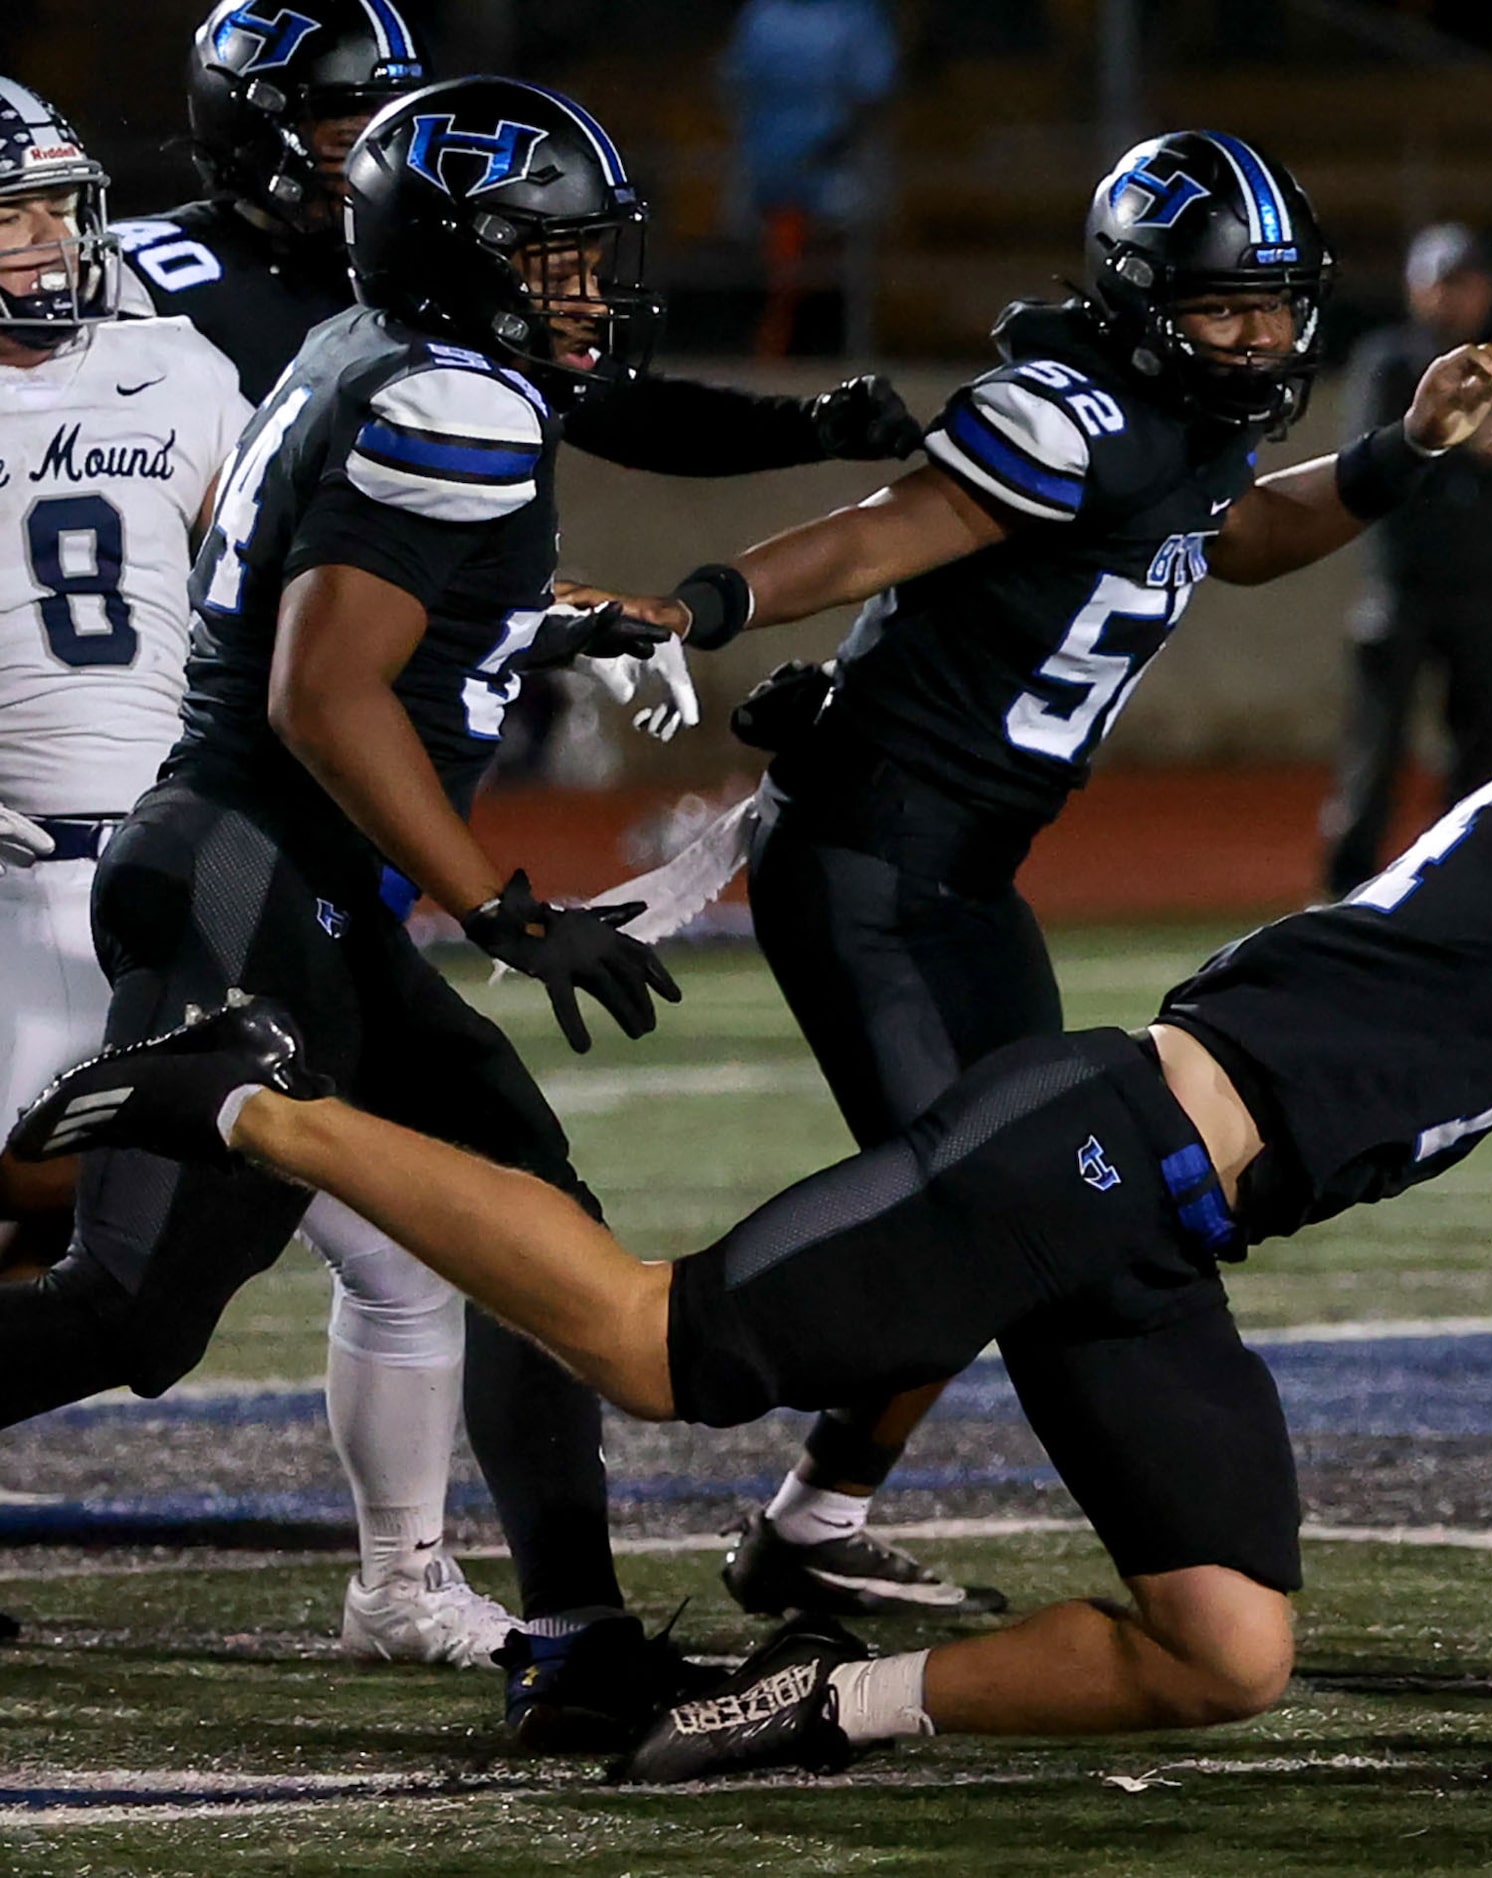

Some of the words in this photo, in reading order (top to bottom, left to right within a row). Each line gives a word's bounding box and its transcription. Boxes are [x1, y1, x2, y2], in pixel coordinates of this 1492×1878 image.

[1019, 360, 1124, 436] 52
[29, 422, 175, 482] Mound
[22, 492, 140, 670] 8
